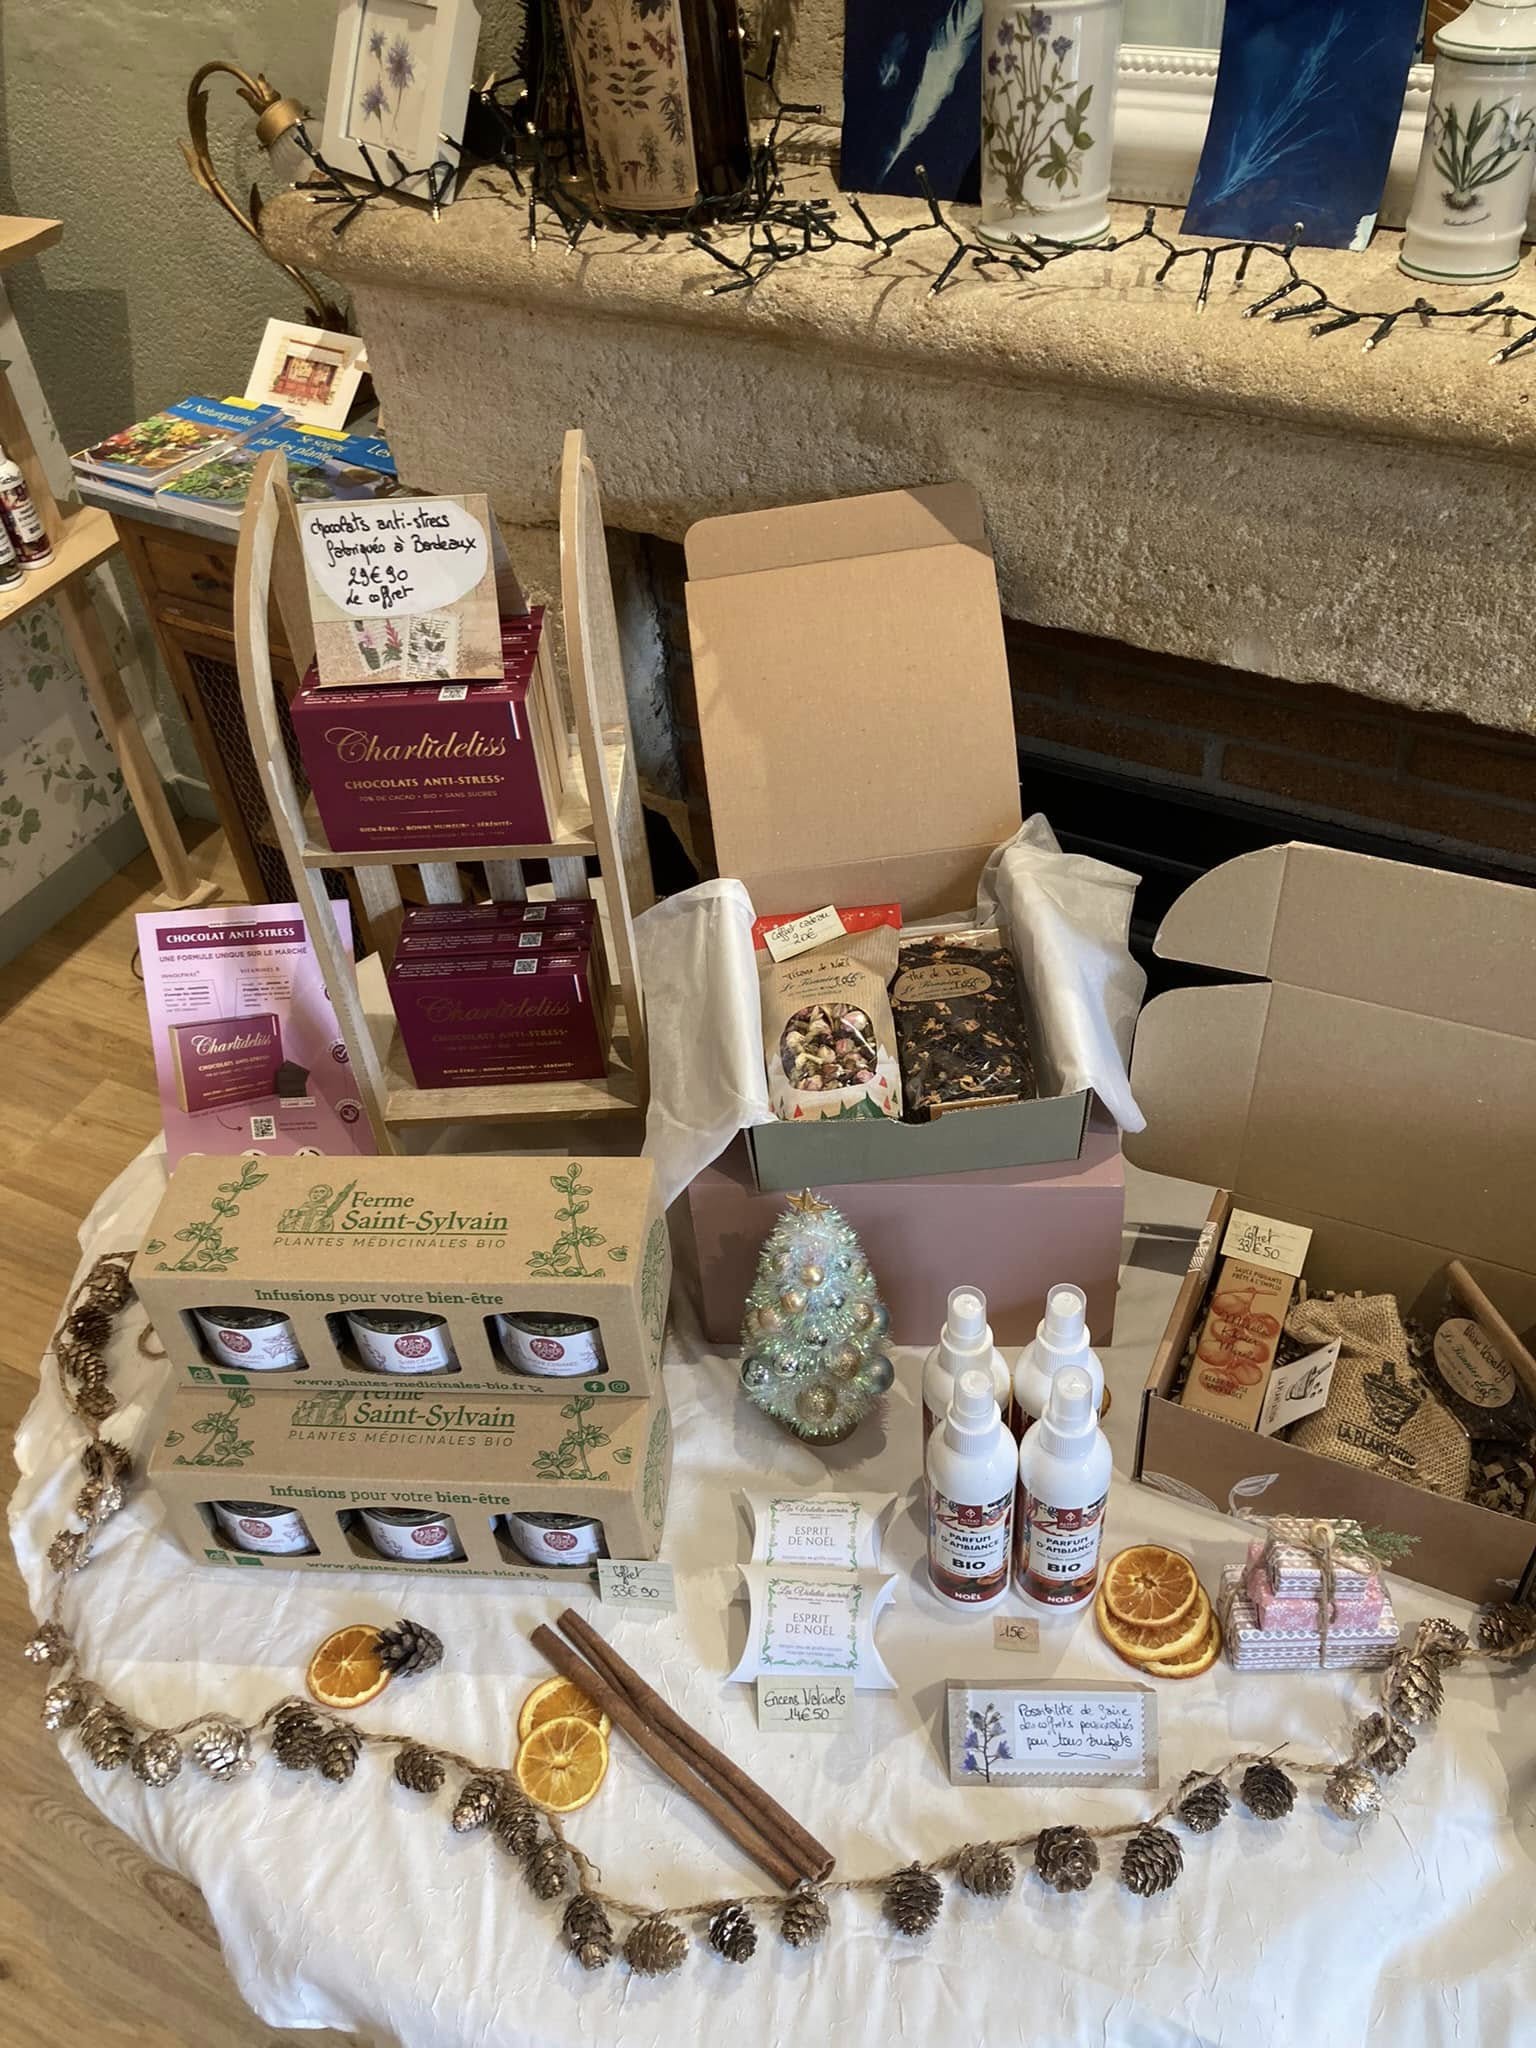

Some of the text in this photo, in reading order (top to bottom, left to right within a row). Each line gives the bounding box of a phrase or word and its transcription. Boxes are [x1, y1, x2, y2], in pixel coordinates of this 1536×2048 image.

[376, 506, 450, 531] anti-stress
[393, 535, 405, 552] à
[411, 534, 477, 554] Bordeaux
[368, 585, 414, 609] coffret
[324, 726, 507, 764] Charlideliss
[344, 777, 419, 790] CHOCOLATS
[166, 927, 296, 944] CHOCOLAT ANTI-STRESS
[177, 952, 214, 962] FORMULE
[215, 951, 245, 959] UNIQUE
[247, 950, 262, 958] SUR
[263, 949, 273, 957] LE
[351, 1191, 415, 1208] Ferme
[341, 1209, 509, 1235] Saint-Sylvain
[272, 1235, 506, 1249] PLANTES MÉDICINALES BIO
[254, 1289, 504, 1305] Infusions pour votre bien-être
[293, 1377, 525, 1391] www.plantes-medicinales-bio.fr
[353, 1402, 516, 1430] Saint-Sylvain
[288, 1430, 514, 1447] PLANTES MÉDICINALES BIO
[269, 1485, 511, 1505] Infusions pour votre bien-être
[794, 1526, 830, 1536] ESPRIT
[788, 1535, 803, 1546] DE
[952, 1558, 986, 1570] BIO
[1047, 1562, 1082, 1573] BIO
[954, 1591, 981, 1600] NOËL
[1047, 1595, 1075, 1604] NOËL
[792, 1612, 830, 1624] ESPRIT
[785, 1623, 801, 1634] DE
[764, 1690, 800, 1708] Encens
[1080, 1703, 1092, 1715] de
